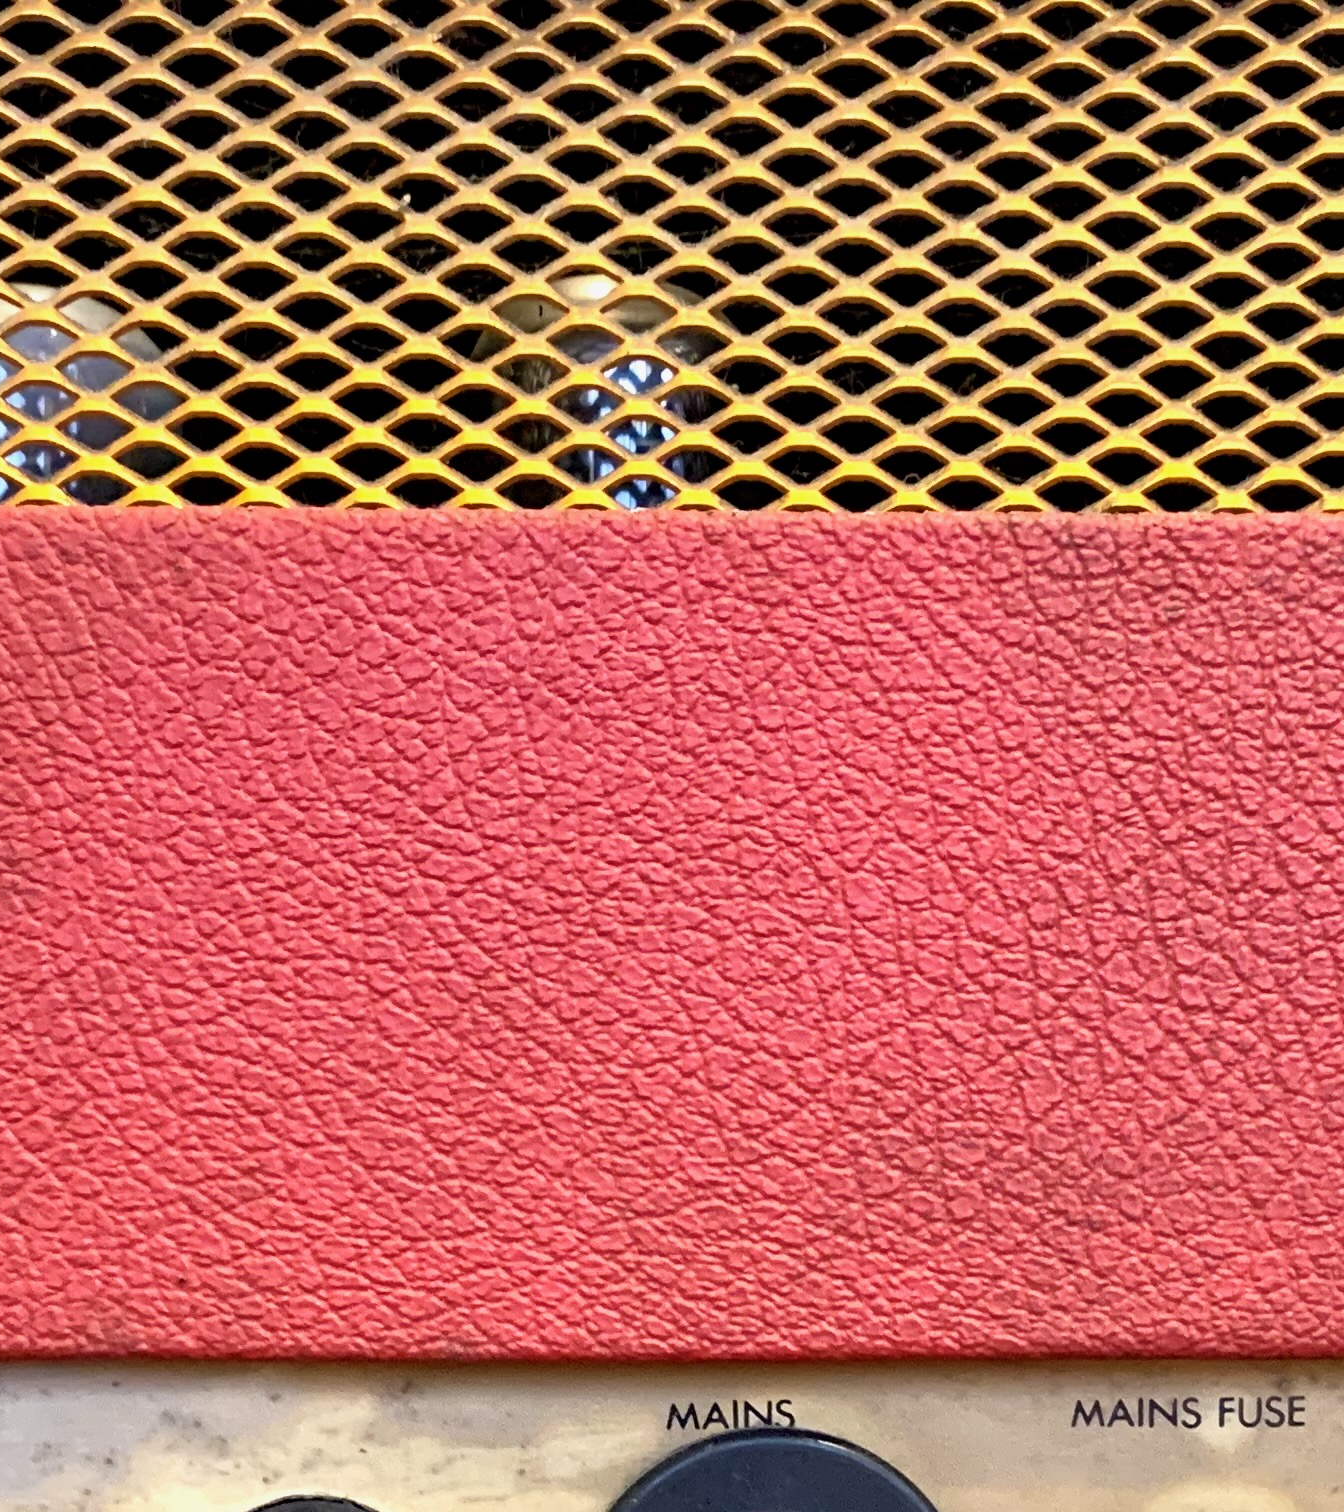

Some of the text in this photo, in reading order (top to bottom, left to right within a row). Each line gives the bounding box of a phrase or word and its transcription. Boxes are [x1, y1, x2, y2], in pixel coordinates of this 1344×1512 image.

[666, 1399, 796, 1430] MAINS
[1070, 1394, 1307, 1431] MAINS FUSE
